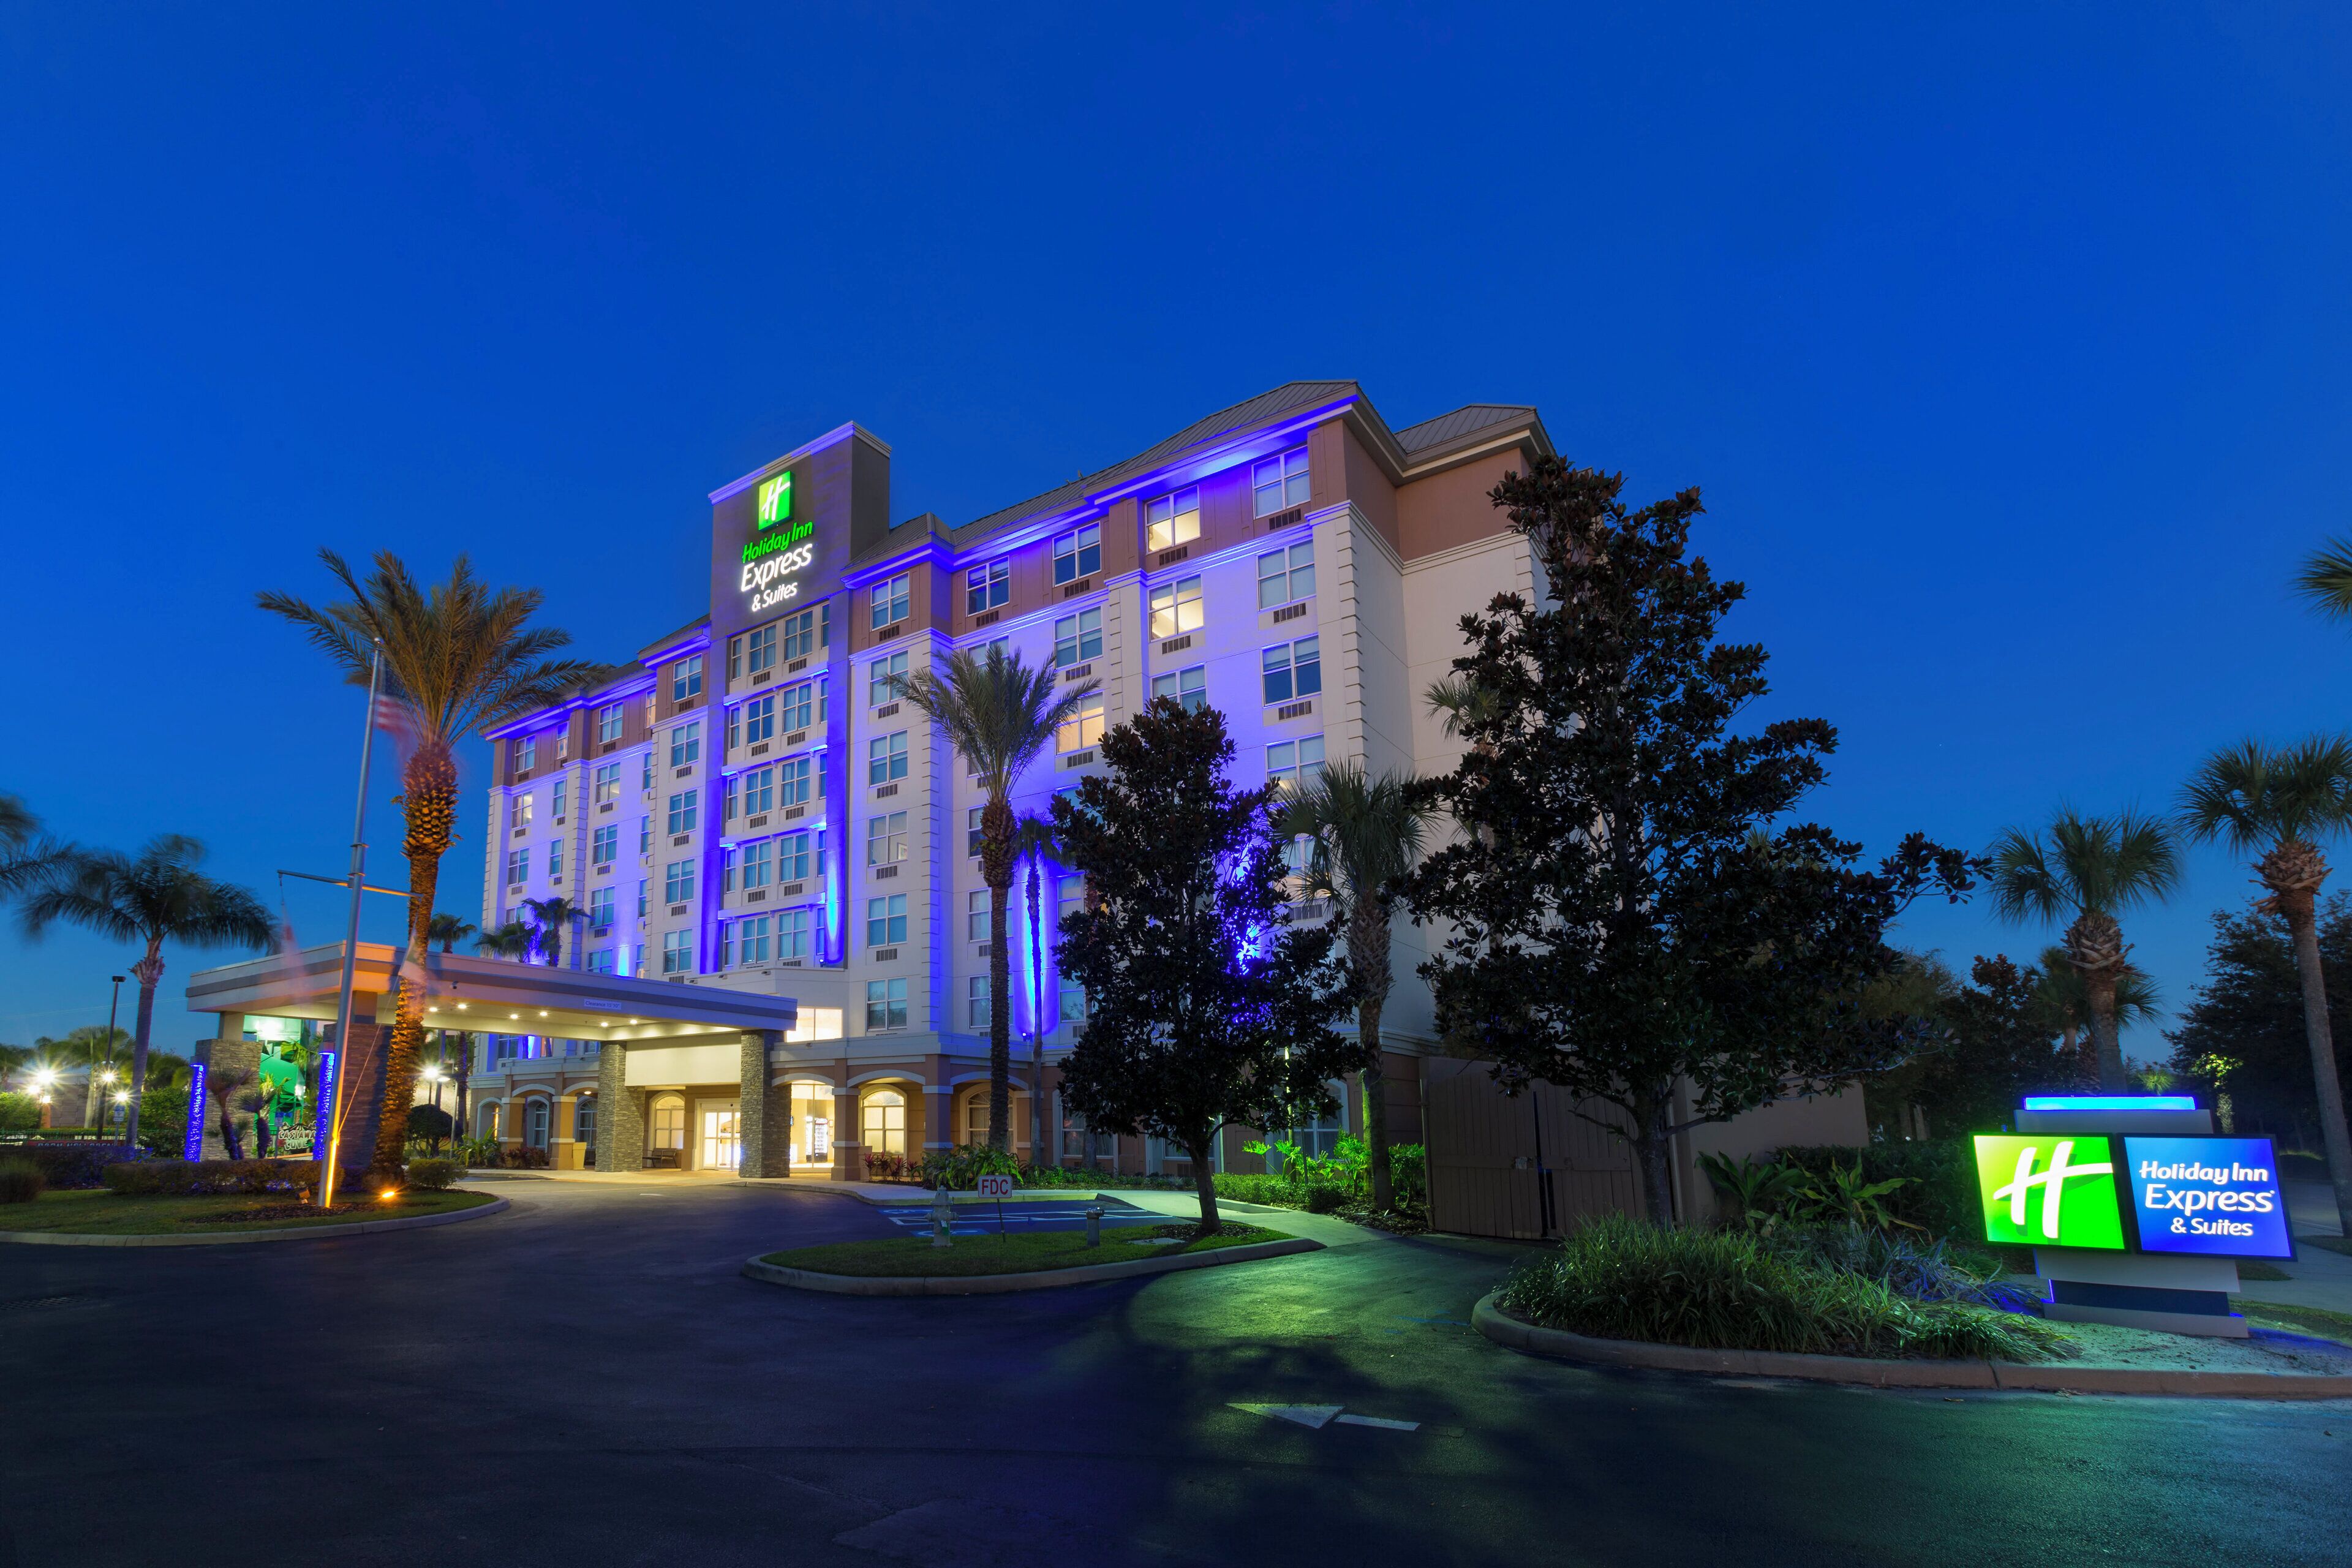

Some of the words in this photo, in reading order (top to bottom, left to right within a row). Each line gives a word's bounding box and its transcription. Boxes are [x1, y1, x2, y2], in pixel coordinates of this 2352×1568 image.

[761, 477, 791, 521] H
[742, 531, 790, 564] Holiday
[791, 521, 813, 541] Inn
[741, 544, 813, 592] Express
[752, 594, 761, 612] &
[763, 582, 798, 608] Suites
[278, 1129, 315, 1140] CASTAWA
[982, 1179, 1008, 1195] FDC
[2139, 1161, 2229, 1185] Holiday
[2232, 1162, 2268, 1182] Inn
[1993, 1140, 2114, 1238] H
[2145, 1183, 2275, 1216] Express
[2170, 1218, 2187, 1234] &
[2190, 1218, 2253, 1237] Suites
